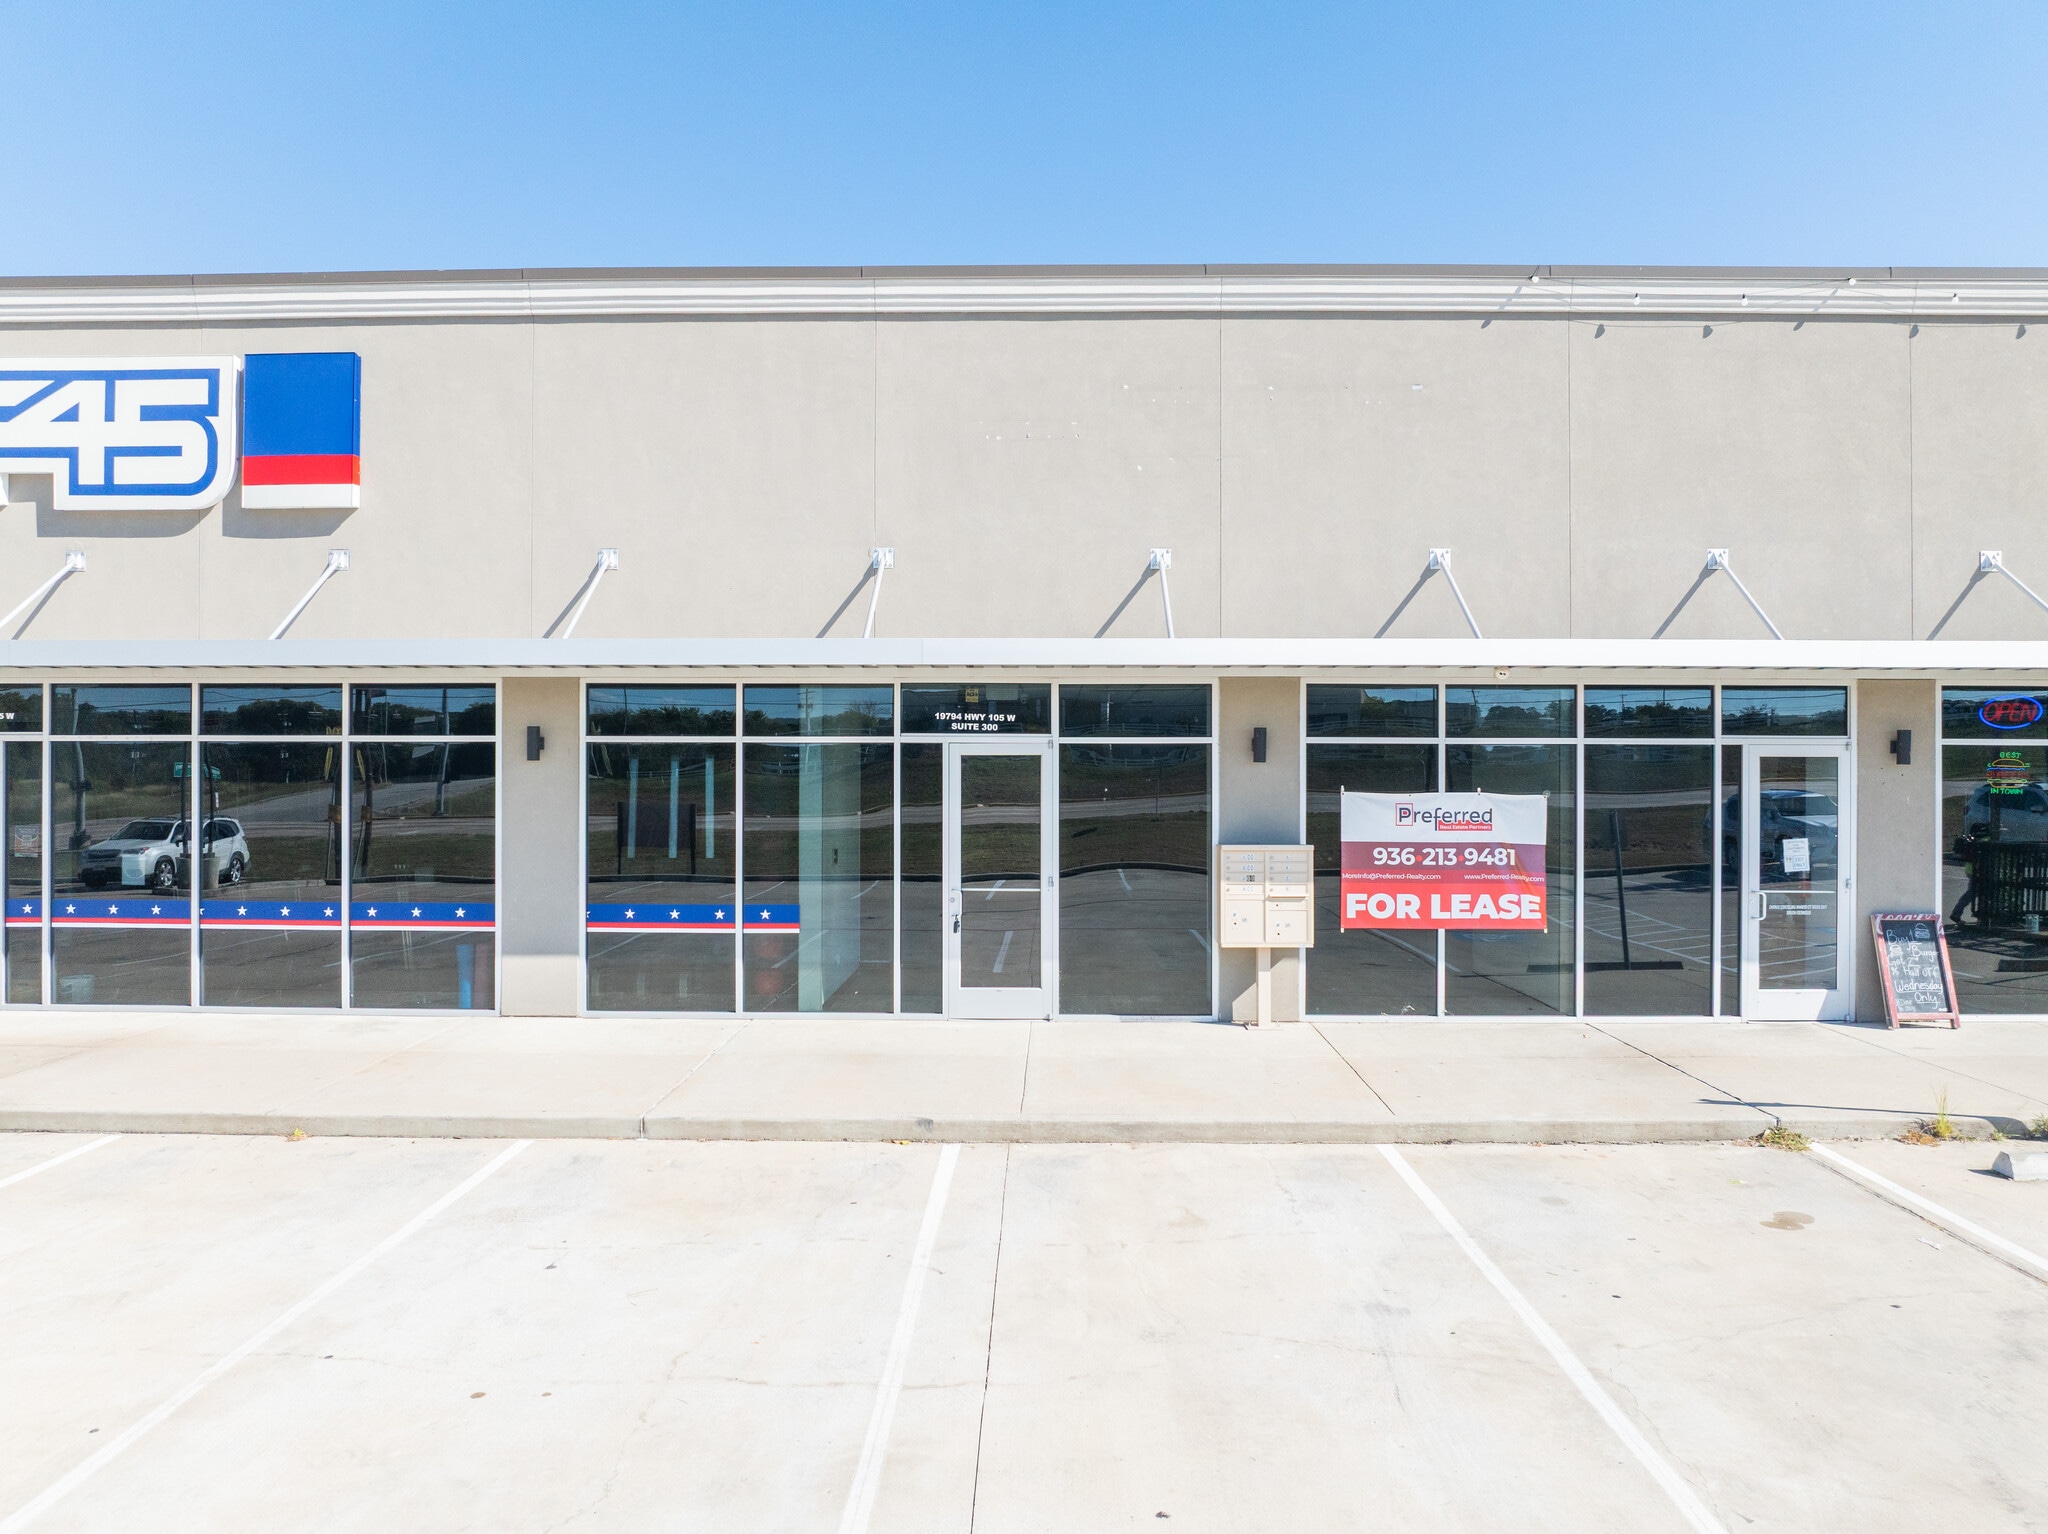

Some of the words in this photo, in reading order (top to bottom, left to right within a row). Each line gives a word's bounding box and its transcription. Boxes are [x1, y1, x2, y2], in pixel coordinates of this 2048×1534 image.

[934, 712, 962, 720] 19794
[1983, 702, 2038, 722] OPEN
[1398, 807, 1492, 831] Preferred
[1464, 873, 1544, 882] www.Preferred-Realty.com
[1346, 892, 1421, 919] FOR
[1431, 893, 1542, 920] LEASE
[1894, 978, 1944, 994] Wednesday
[1914, 992, 1938, 1009] Only
